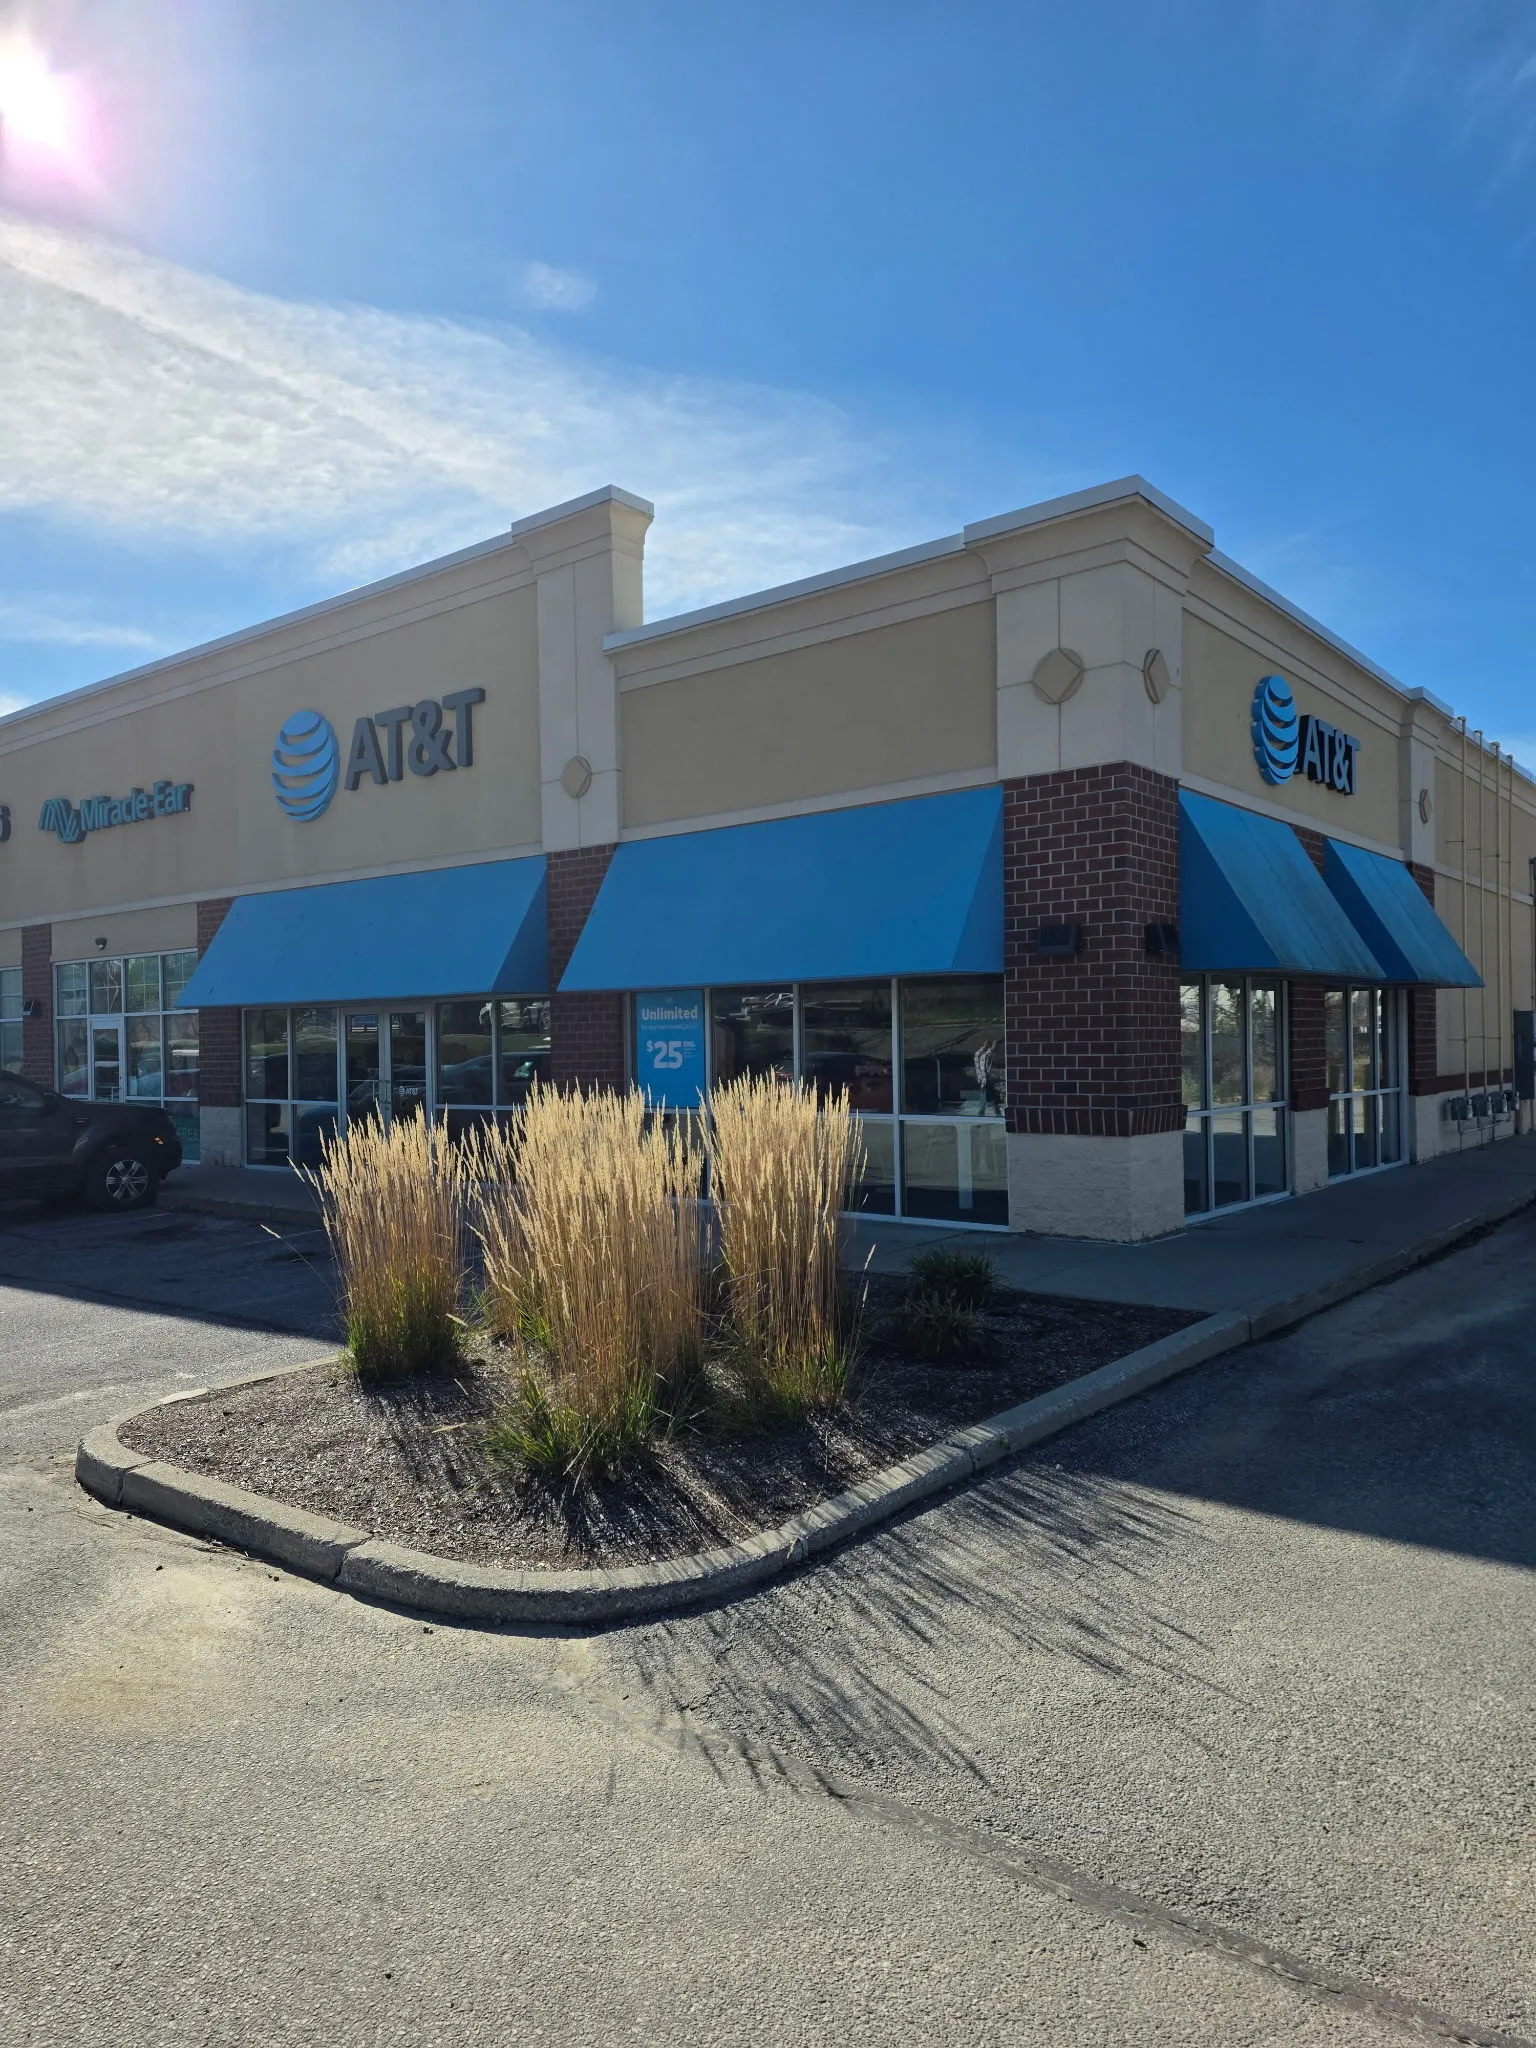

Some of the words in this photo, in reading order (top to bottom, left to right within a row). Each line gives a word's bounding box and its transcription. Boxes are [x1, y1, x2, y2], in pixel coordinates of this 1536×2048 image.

[344, 687, 486, 791] AT&T
[1297, 714, 1361, 796] AT&T
[79, 779, 194, 831] Miracle-Ear
[642, 1006, 698, 1020] Unlimited
[646, 1040, 683, 1068] $25
[405, 1087, 419, 1096] AT&T
